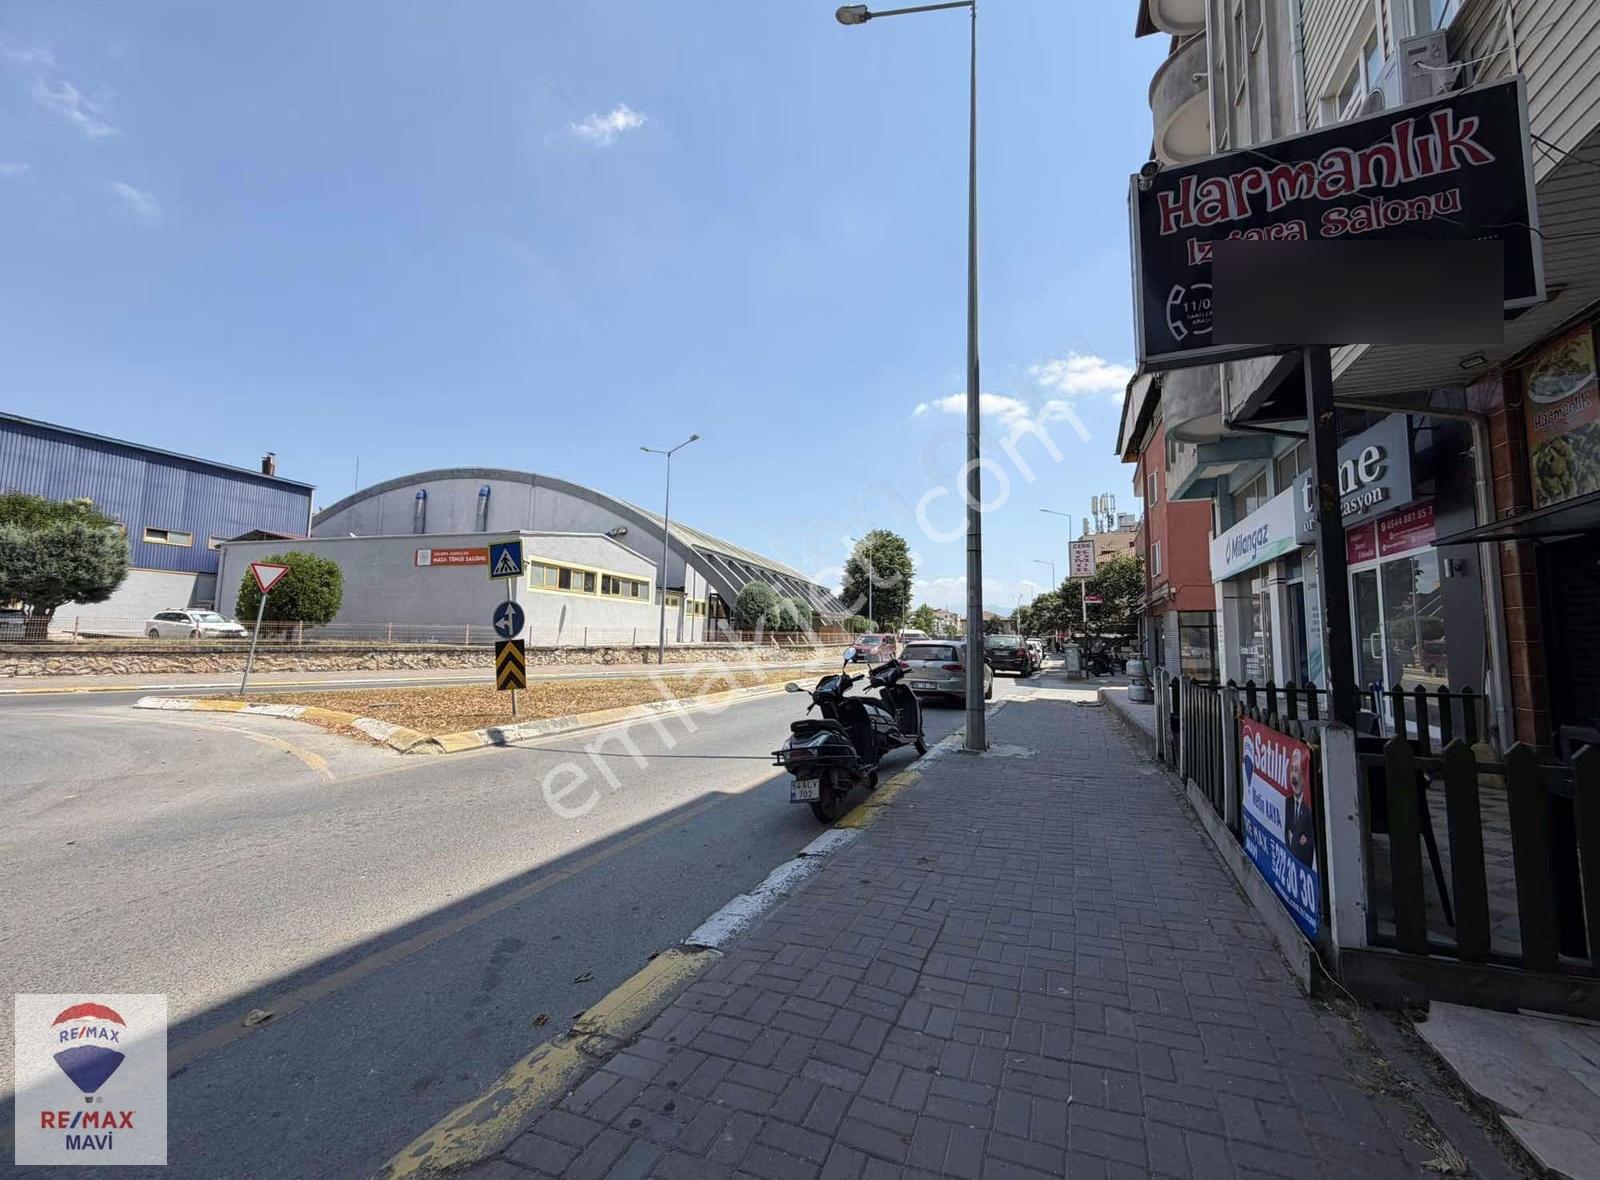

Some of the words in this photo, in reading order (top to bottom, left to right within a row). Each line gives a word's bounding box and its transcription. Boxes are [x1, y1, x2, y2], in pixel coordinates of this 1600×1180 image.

[1157, 107, 1496, 236] Harmanlık
[1231, 524, 1269, 560] Milangaz
[1254, 732, 1290, 791] Satılık
